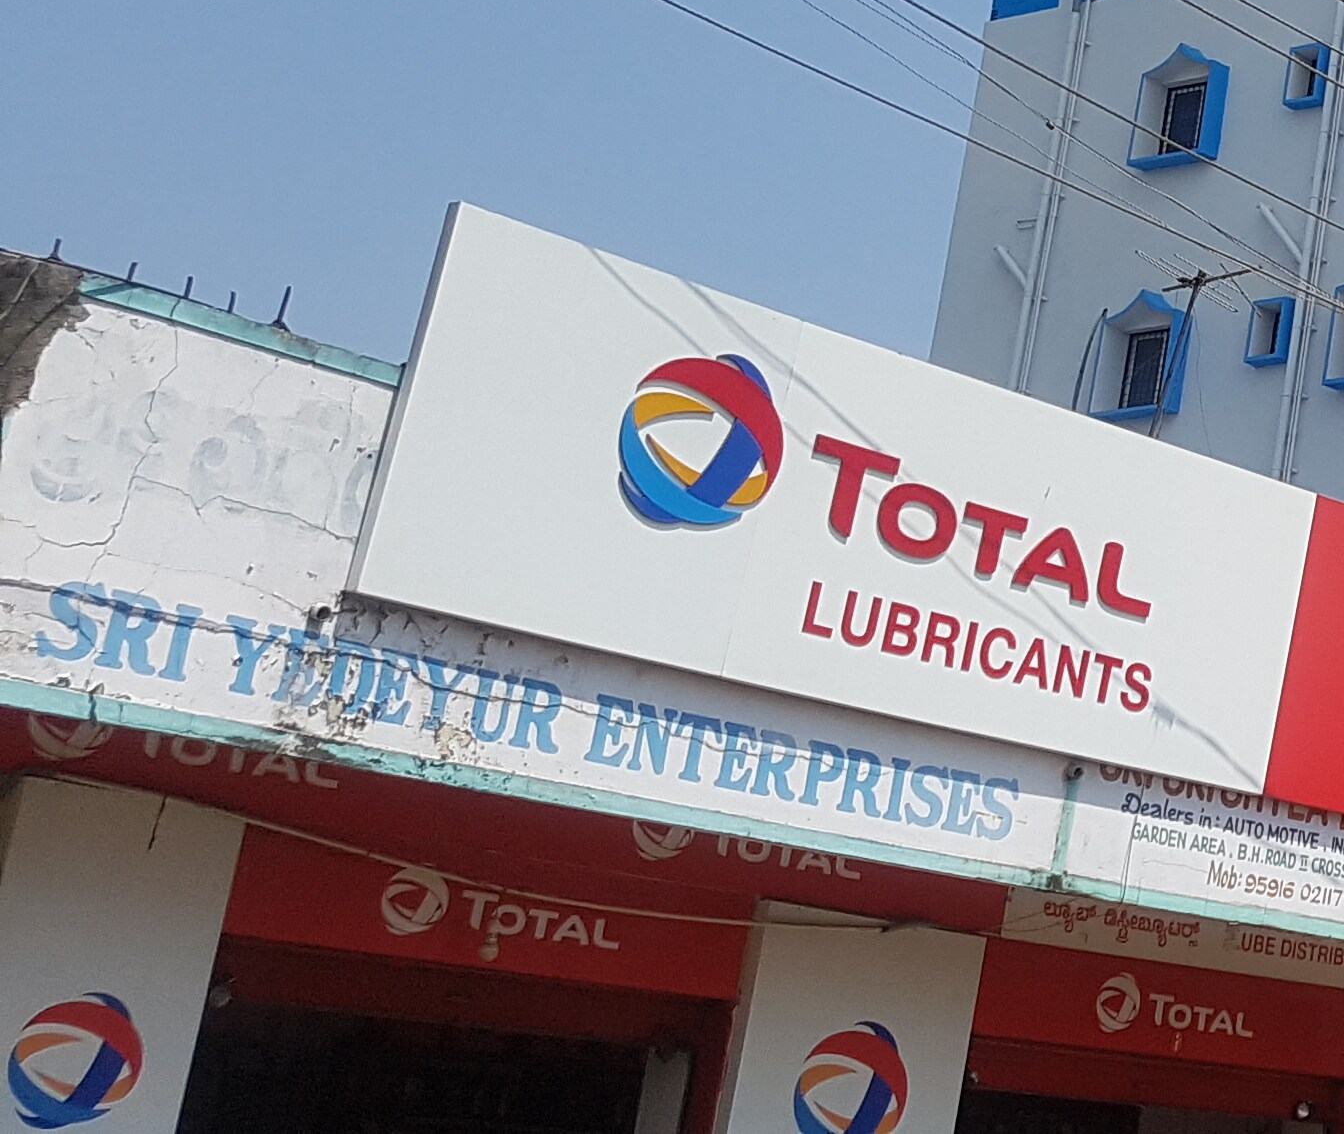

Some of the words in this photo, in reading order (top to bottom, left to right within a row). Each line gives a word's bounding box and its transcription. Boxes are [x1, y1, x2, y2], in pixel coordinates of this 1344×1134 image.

[801, 580, 1153, 713] LUBRICANTS
[34, 580, 204, 680] SRI
[226, 614, 559, 756] YEDEYUR
[583, 693, 1020, 841] ENTERPRISES
[1121, 793, 1194, 825] Dealers
[1223, 817, 1265, 840] AUTO
[1131, 822, 1187, 850] GARDEN
[1207, 860, 1243, 890] Mob:
[1244, 874, 1296, 899] 95916
[1300, 884, 1343, 907] 02117
[462, 889, 619, 951] TOTAL
[1149, 993, 1254, 1039] TOTAL
